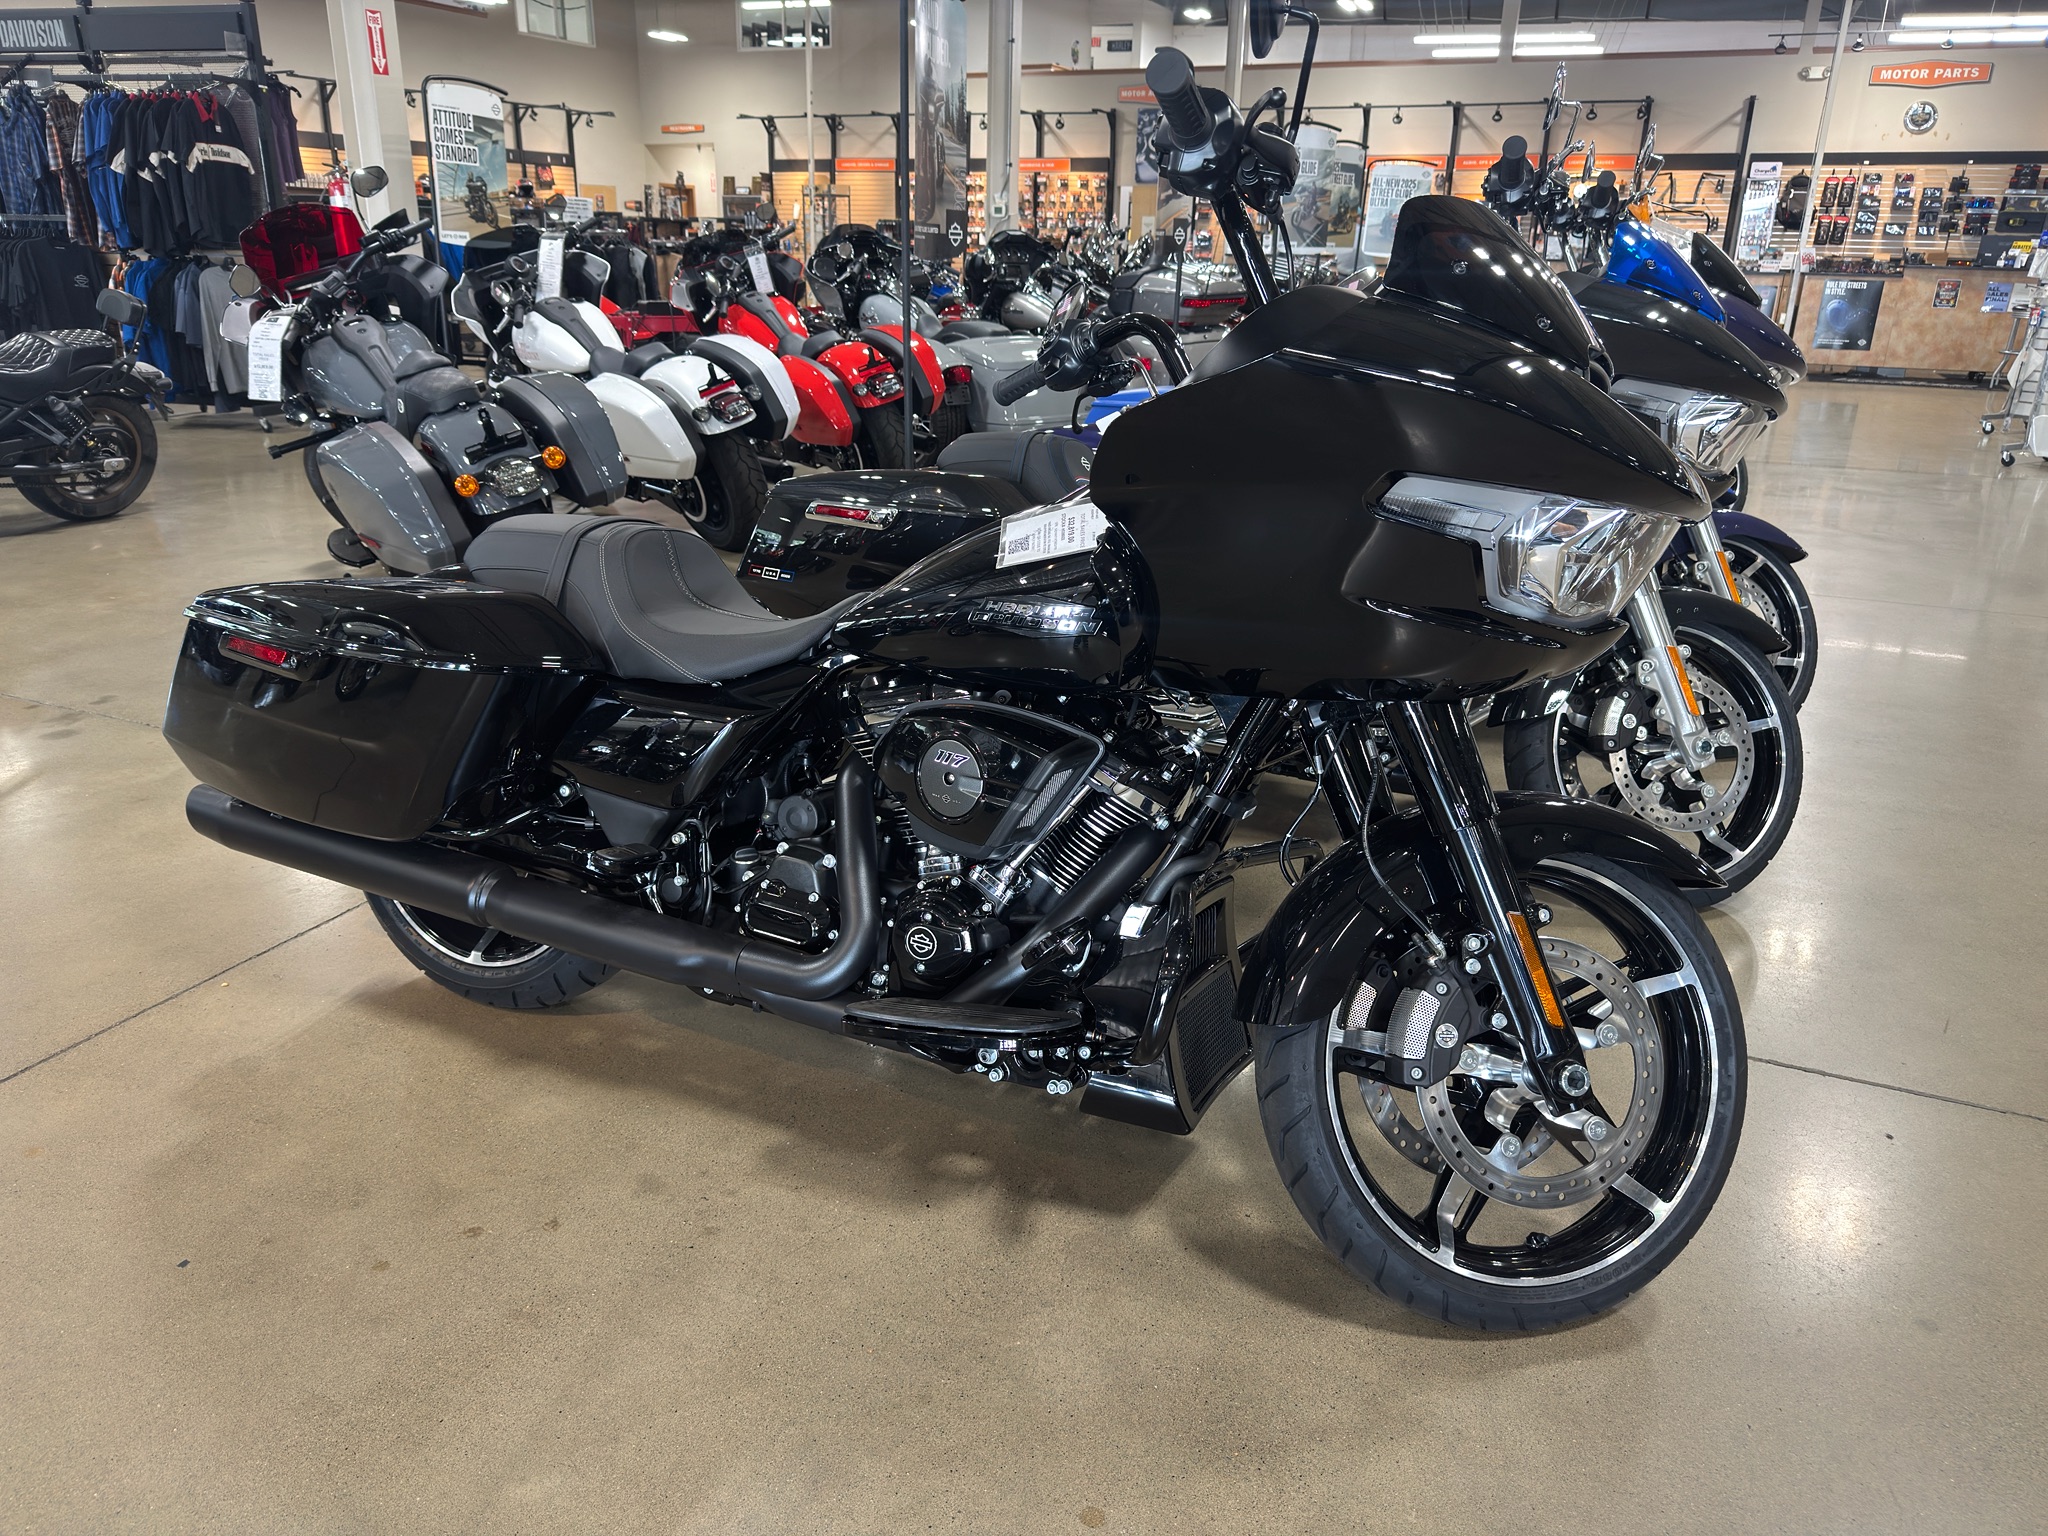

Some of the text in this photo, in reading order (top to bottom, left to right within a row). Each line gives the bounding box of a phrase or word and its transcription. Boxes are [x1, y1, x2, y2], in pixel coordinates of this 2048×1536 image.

[368, 15, 380, 25] FIRE
[0, 19, 67, 48] DAVIDSON
[1880, 67, 1980, 80] MOTOR PARTS
[432, 108, 473, 130] ATTITUDE
[433, 126, 464, 145] COMES
[435, 143, 478, 165] STANDARD
[1301, 160, 1318, 175] GLIDE
[1400, 178, 1417, 190] 2025
[1370, 187, 1413, 199] STREET GLIDE
[1370, 197, 1389, 208] ULTRA
[1847, 282, 1867, 290] STREETS
[934, 748, 970, 768] 117
